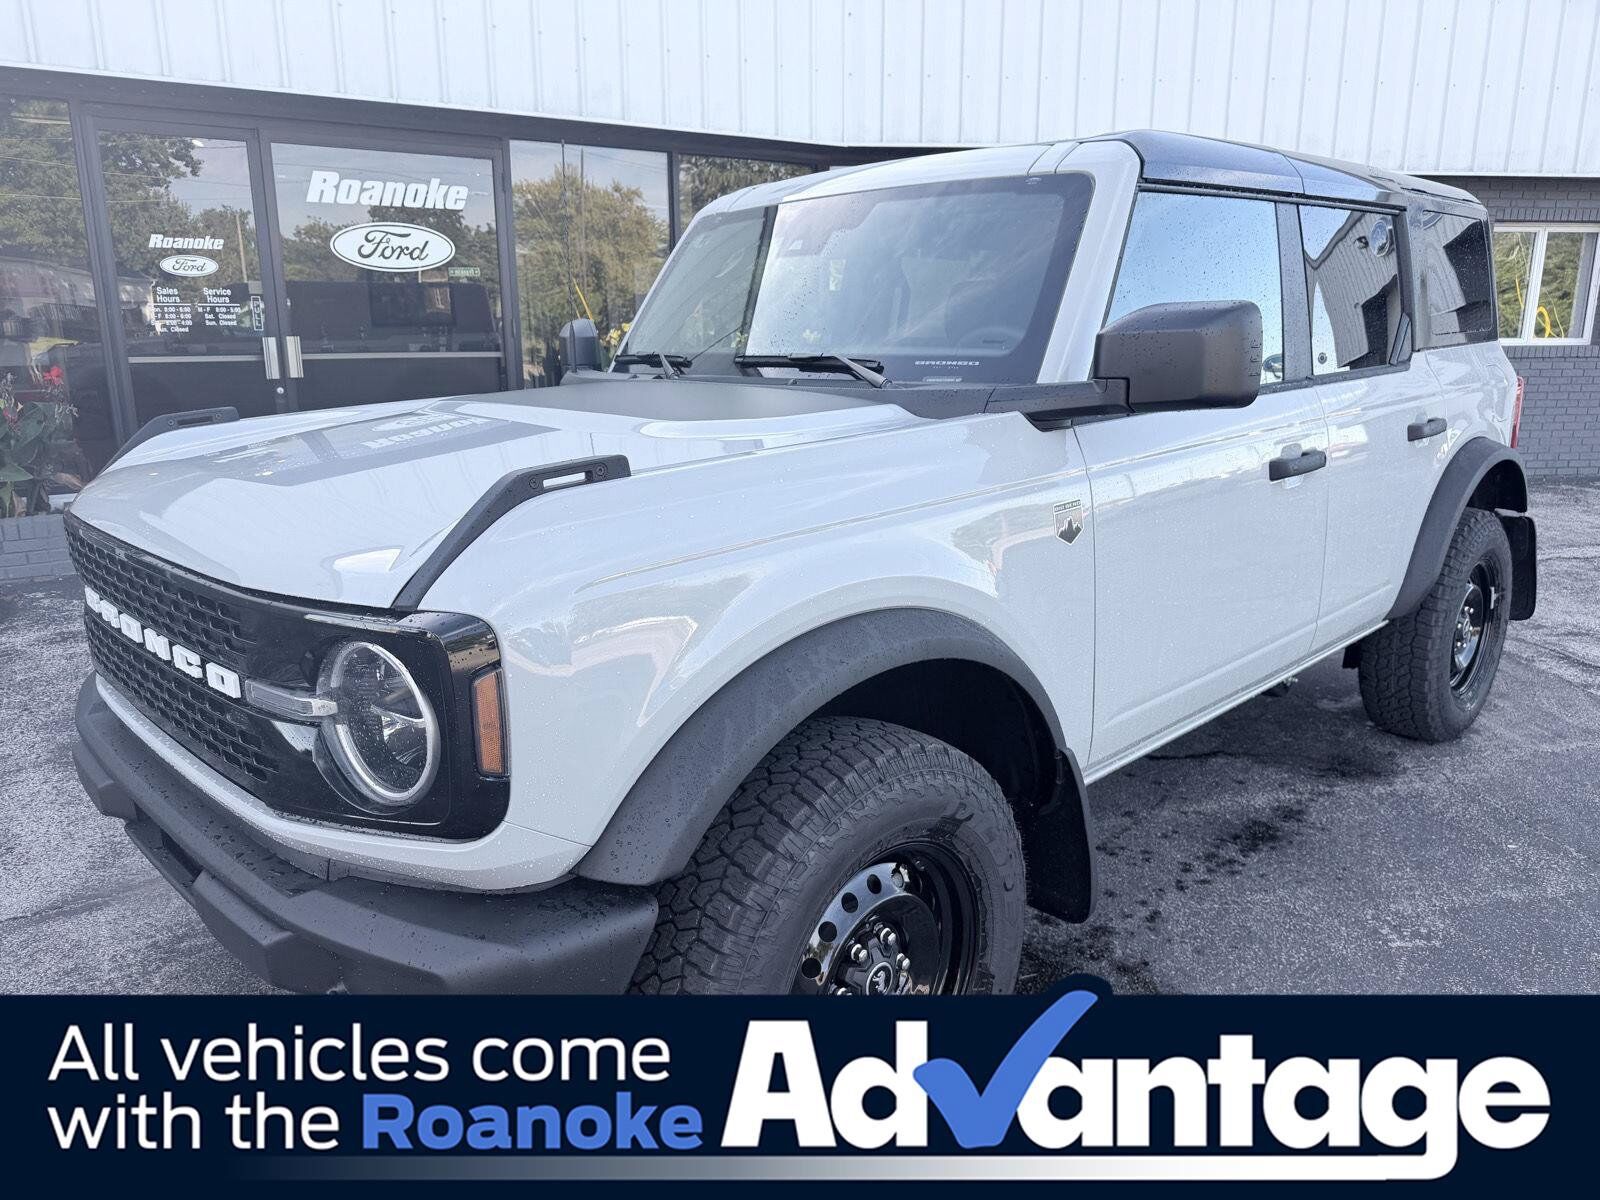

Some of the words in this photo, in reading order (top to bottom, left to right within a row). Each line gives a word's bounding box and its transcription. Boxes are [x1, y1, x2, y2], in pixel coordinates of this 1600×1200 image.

[306, 170, 469, 210] Roanoke
[148, 233, 225, 250] Roanoke
[357, 229, 430, 261] Ford
[172, 258, 206, 272] Ford
[156, 286, 178, 295] Sales
[203, 287, 231, 296] Service
[157, 294, 180, 303] Hours
[207, 295, 230, 304] Hours
